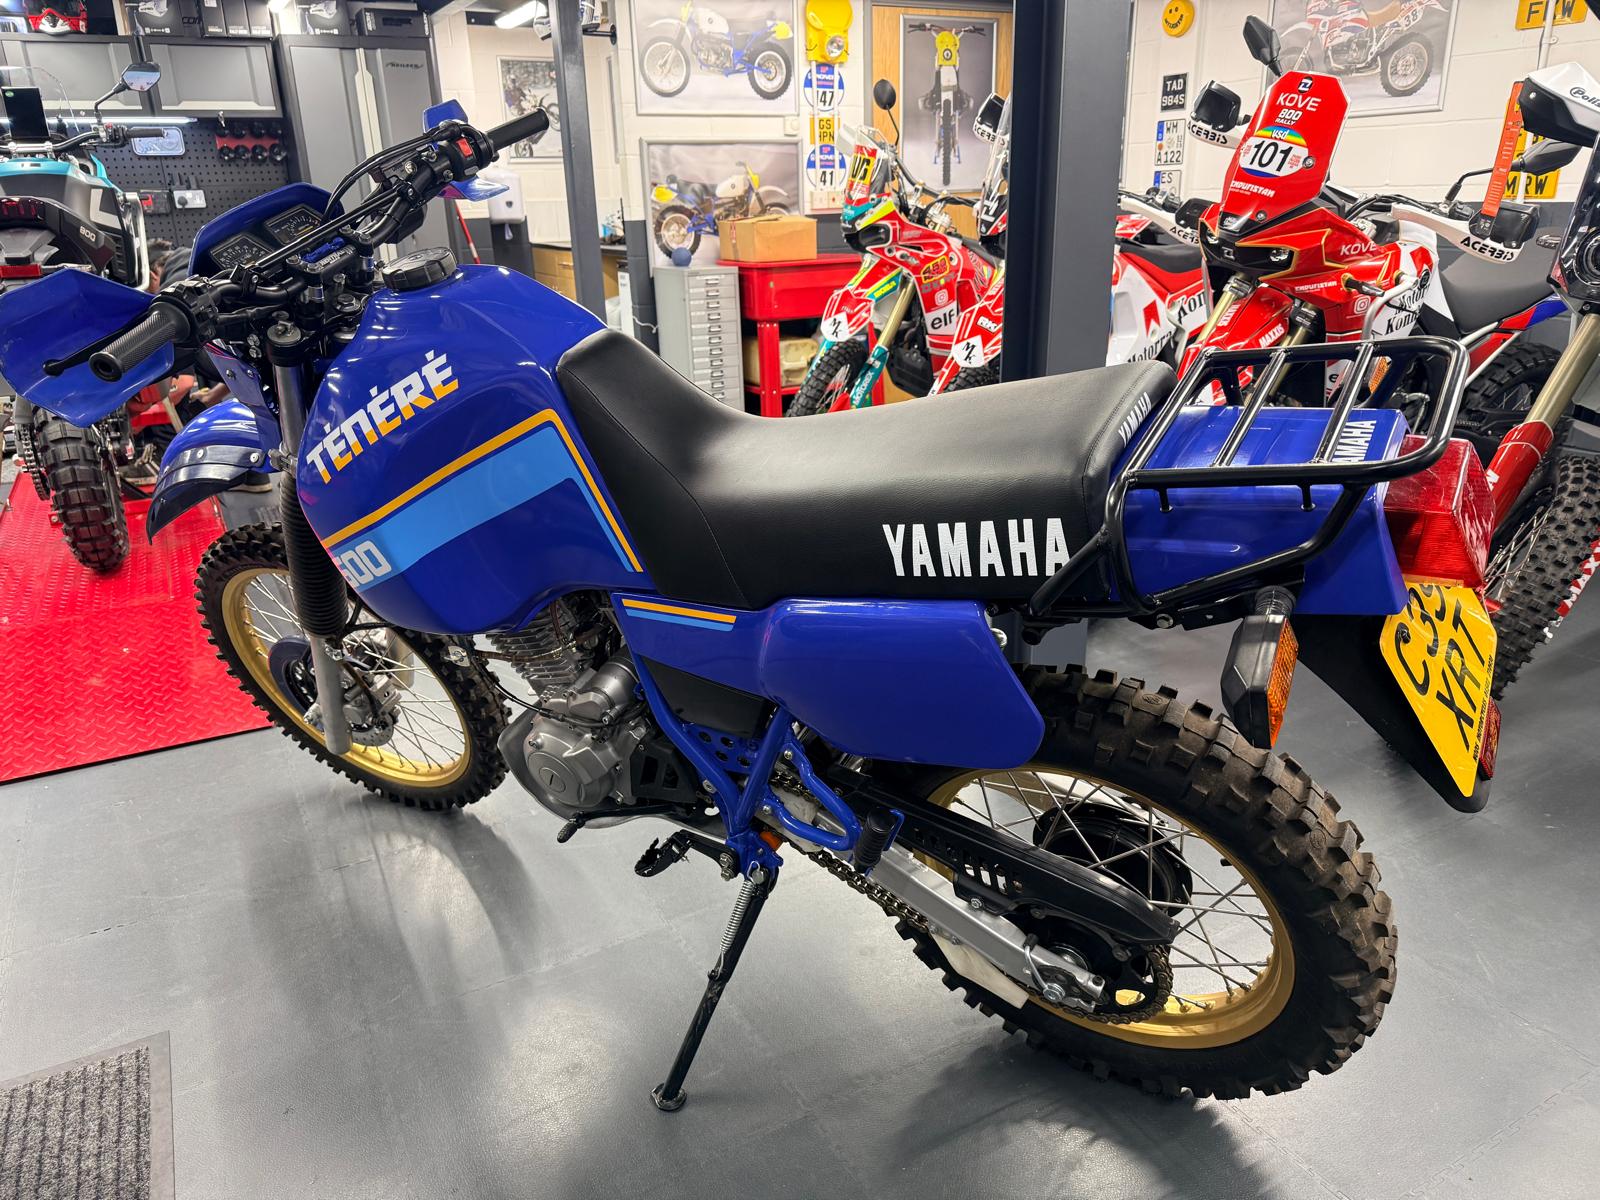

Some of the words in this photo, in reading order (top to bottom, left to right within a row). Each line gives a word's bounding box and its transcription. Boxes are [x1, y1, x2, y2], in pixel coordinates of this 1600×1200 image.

[1404, 10, 1418, 27] 38
[1166, 79, 1184, 92] TAD
[1276, 92, 1321, 112] KOVE
[1275, 118, 1297, 126] RALLY
[1278, 108, 1303, 121] 800
[1249, 140, 1294, 172] 101
[1160, 172, 1173, 184] ES
[1340, 241, 1377, 256] KOVE
[1460, 236, 1514, 261] ACERBIS
[930, 308, 955, 330] elf
[1258, 322, 1285, 349] MAXXIS
[1118, 391, 1152, 449] YAMAHA
[1332, 420, 1377, 463] AMAHA
[882, 517, 1070, 579] YAMAHA
[1395, 584, 1451, 696] C39
[1436, 598, 1486, 753] XRT
